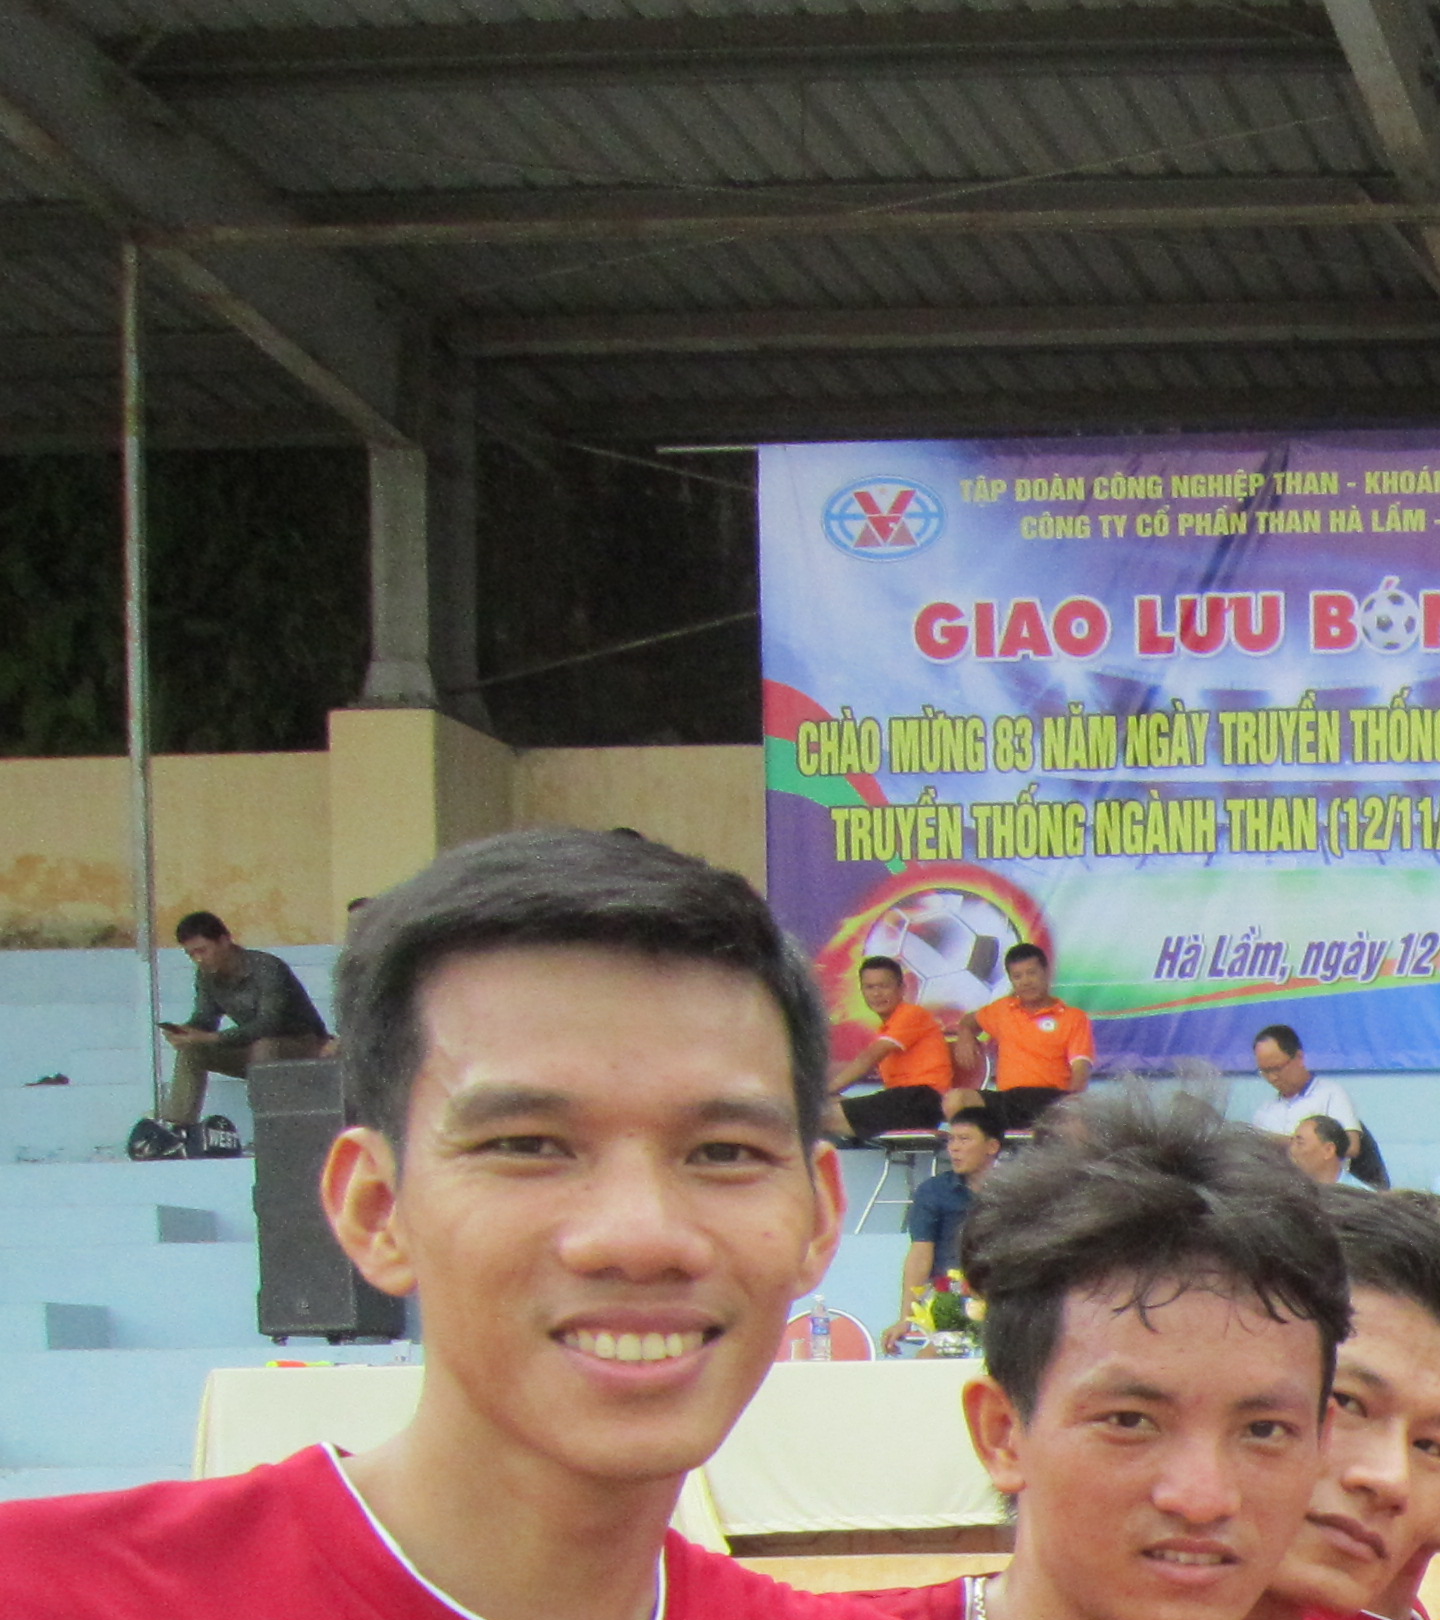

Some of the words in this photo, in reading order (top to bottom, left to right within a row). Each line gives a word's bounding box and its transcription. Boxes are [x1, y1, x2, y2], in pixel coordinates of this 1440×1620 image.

[960, 474, 1007, 506] TẬP
[1015, 473, 1086, 501] ĐOÀN
[1093, 472, 1163, 500] CÔNG
[1171, 469, 1265, 502] NGHIỆP
[1273, 472, 1339, 495] THAN
[1021, 511, 1091, 539] CÔNG
[1099, 515, 1128, 538] TY
[1136, 504, 1171, 537] CỔ
[1178, 505, 1247, 536] PHẦN
[1257, 510, 1322, 533] THAN
[1329, 505, 1364, 533] HÀ
[914, 596, 1112, 661] GIAO
[1135, 591, 1285, 658] LƯU
[798, 706, 881, 776] CHÀO
[890, 704, 985, 774] MỪNG
[994, 717, 1033, 772] 83
[1042, 703, 1117, 770] NĂM
[1125, 698, 1210, 768] NGÀY
[1219, 689, 1340, 766] TRUYỀN
[830, 785, 963, 861] TRUYỀN
[970, 782, 1086, 858] THỐNG
[1093, 789, 1216, 856] NGÀNH
[1225, 796, 1318, 853] THAN
[1153, 930, 1207, 982] Hà
[1300, 930, 1388, 983] ngày
